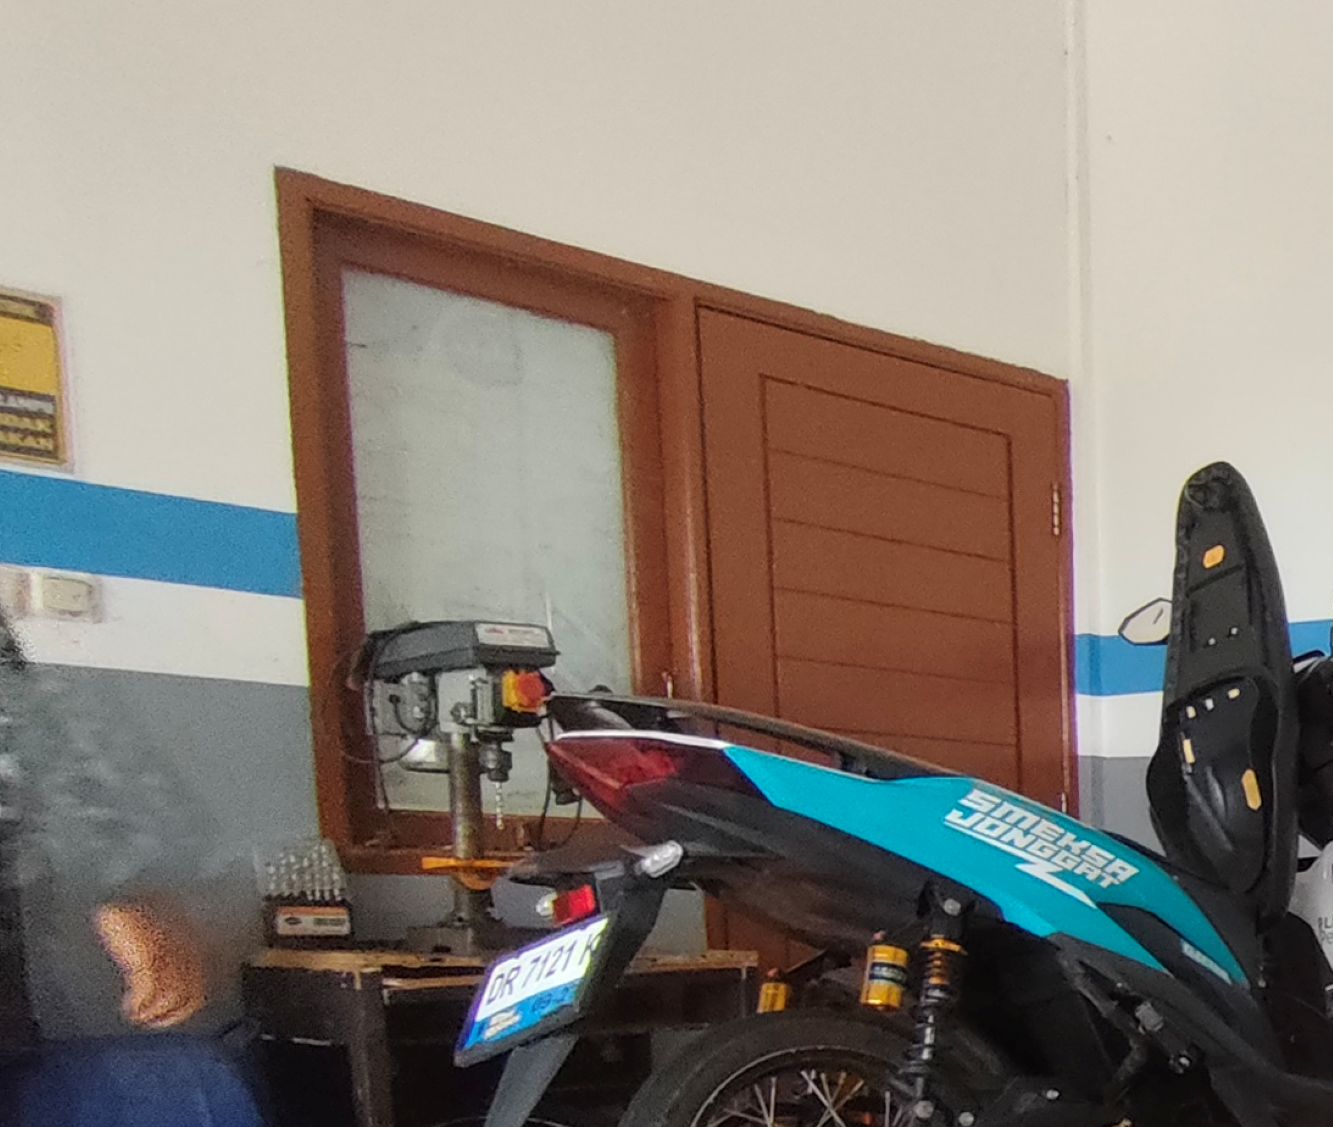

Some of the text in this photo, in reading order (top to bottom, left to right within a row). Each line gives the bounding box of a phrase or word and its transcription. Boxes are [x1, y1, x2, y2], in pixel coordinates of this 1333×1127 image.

[944, 808, 1122, 890] JONGGAT
[958, 788, 1140, 882] SMEKSA
[487, 965, 521, 1005] DR
[522, 940, 578, 988] 7121
